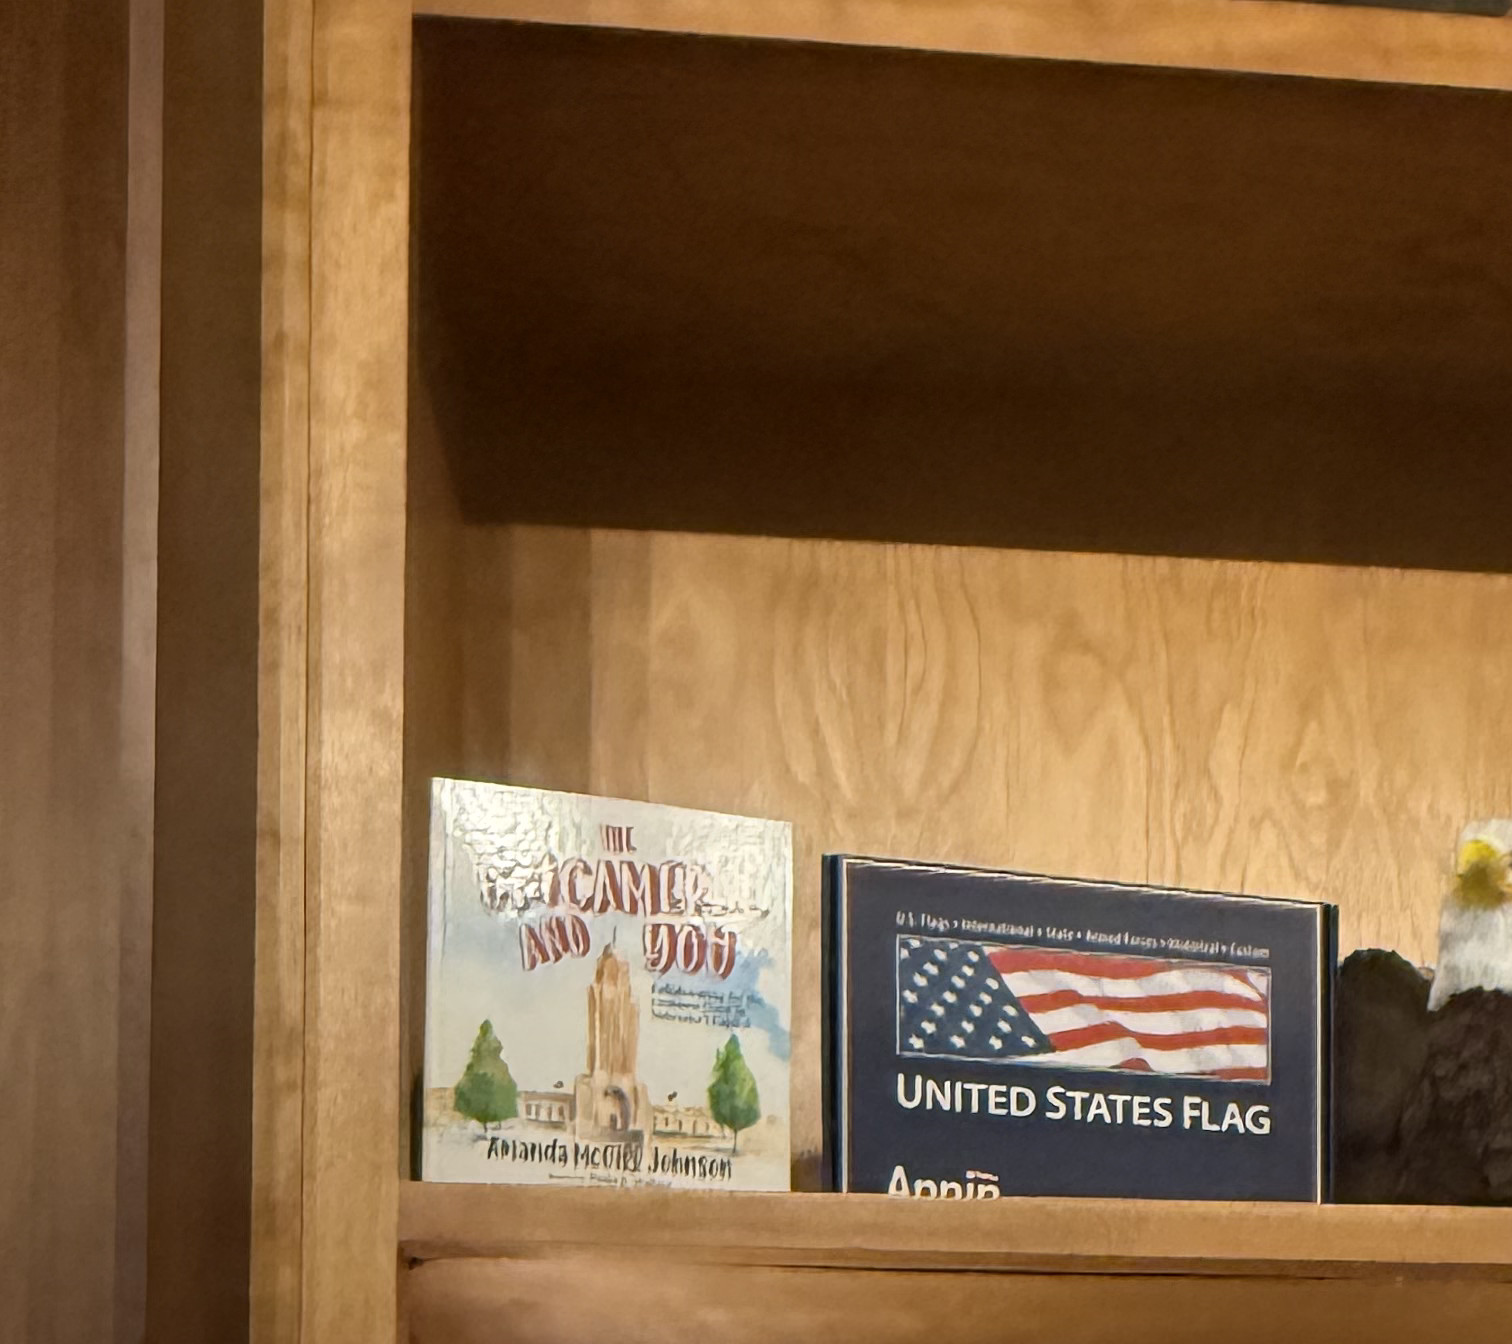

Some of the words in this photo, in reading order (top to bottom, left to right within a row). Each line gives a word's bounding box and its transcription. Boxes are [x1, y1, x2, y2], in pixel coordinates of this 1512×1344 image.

[519, 914, 590, 972] AND
[643, 922, 737, 981] YOU
[896, 1072, 1036, 1118] UNITED
[1045, 1085, 1173, 1129] STATES
[1182, 1101, 1272, 1135] FLAG
